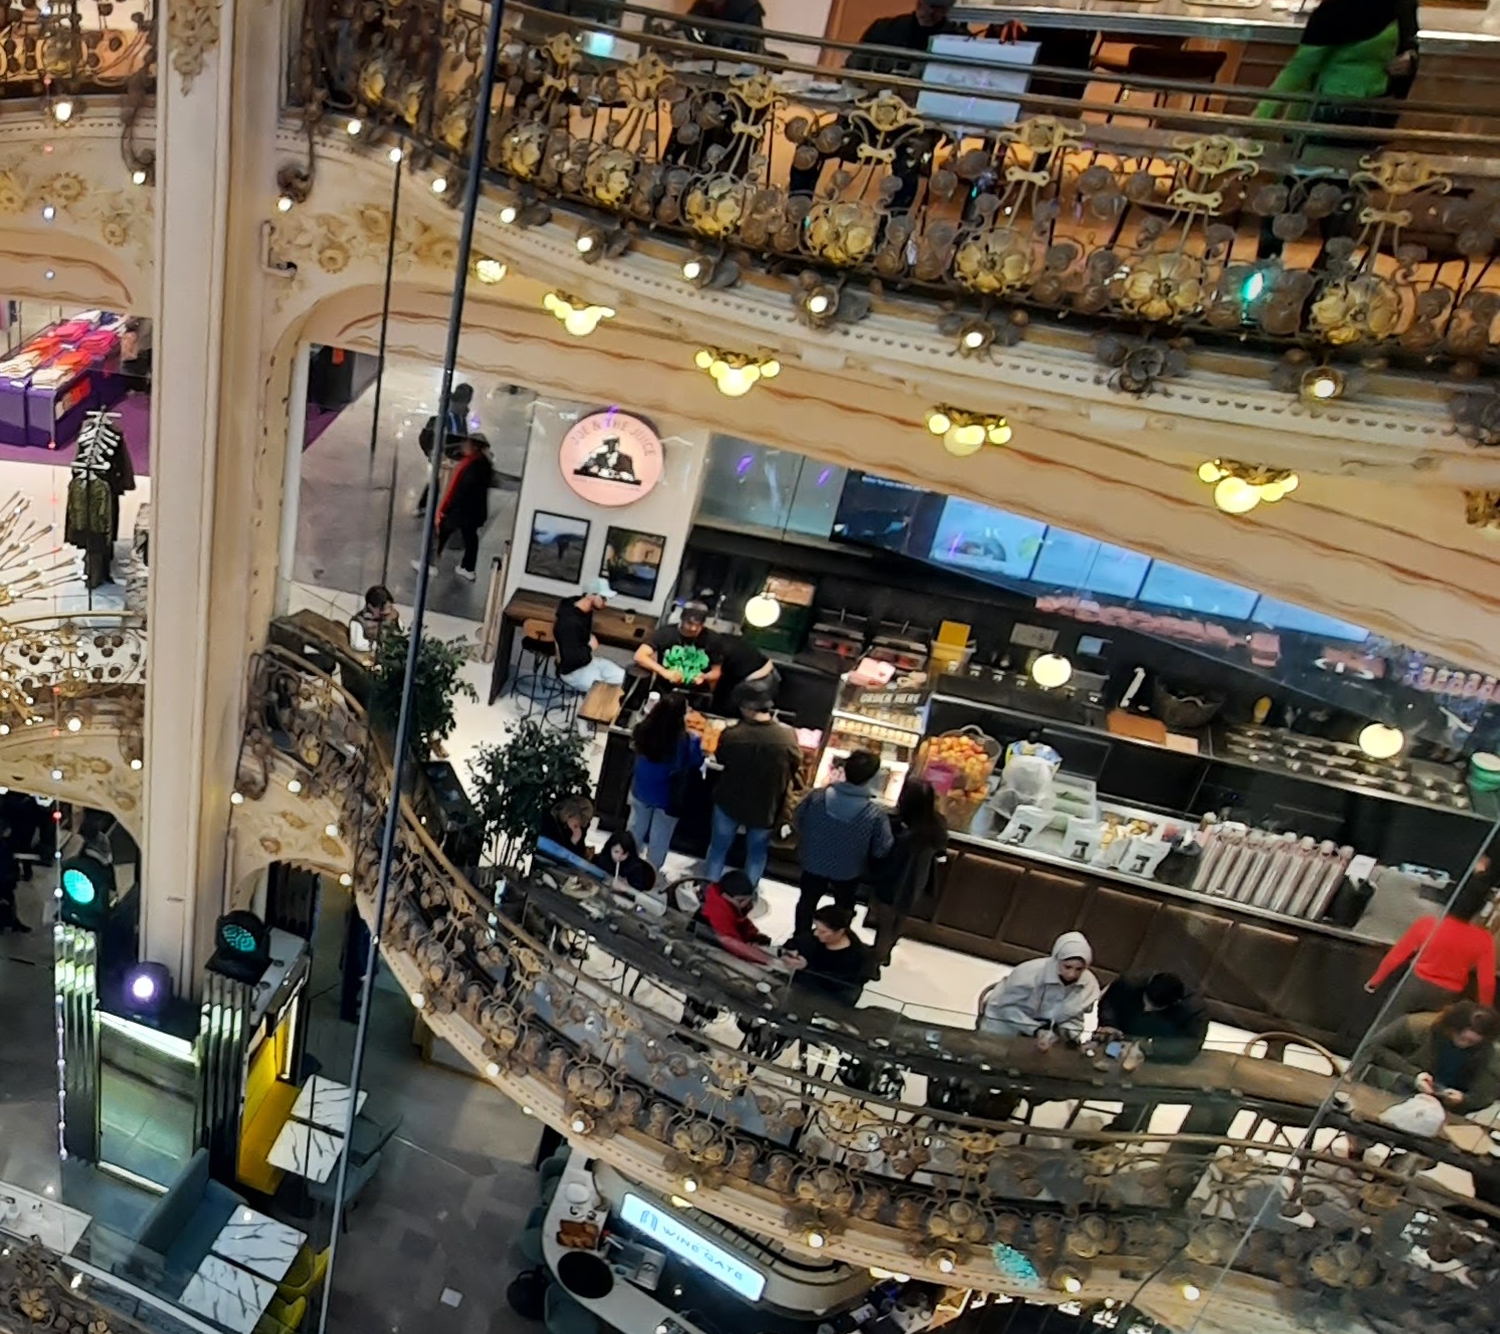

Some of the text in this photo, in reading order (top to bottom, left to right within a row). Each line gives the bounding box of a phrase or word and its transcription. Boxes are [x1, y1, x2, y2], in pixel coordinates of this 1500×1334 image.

[570, 425, 591, 445] JOE
[629, 428, 657, 457] JUICE
[662, 1225, 744, 1282] WINE GATE
